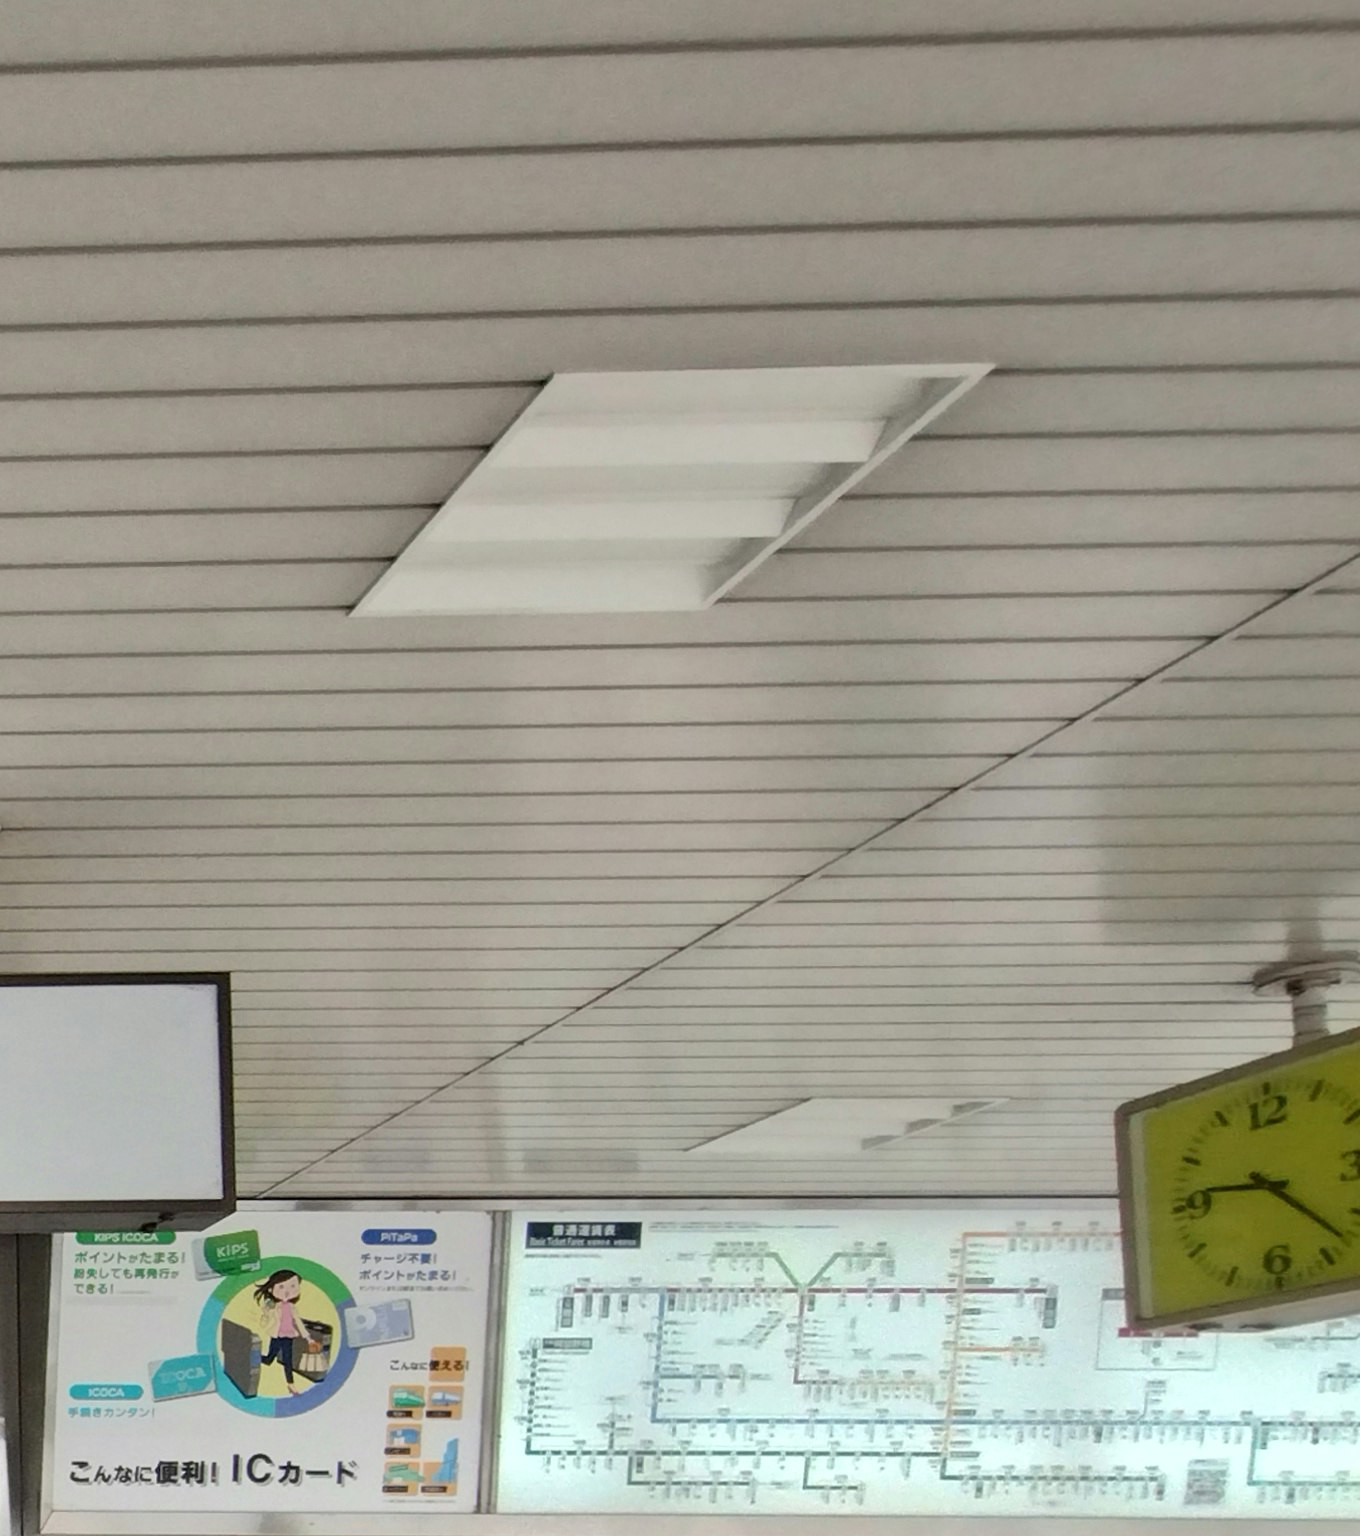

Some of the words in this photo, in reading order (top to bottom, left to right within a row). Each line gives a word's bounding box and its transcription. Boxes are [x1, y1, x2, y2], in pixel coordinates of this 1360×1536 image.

[1248, 1095, 1288, 1131] 12
[1186, 1190, 1212, 1220] 9
[94, 1232, 120, 1243] KIPS
[122, 1232, 159, 1243] ICOCA
[1261, 1245, 1292, 1275] 6
[74, 1283, 114, 1295] できる！
[88, 1387, 126, 1398] ICOCA
